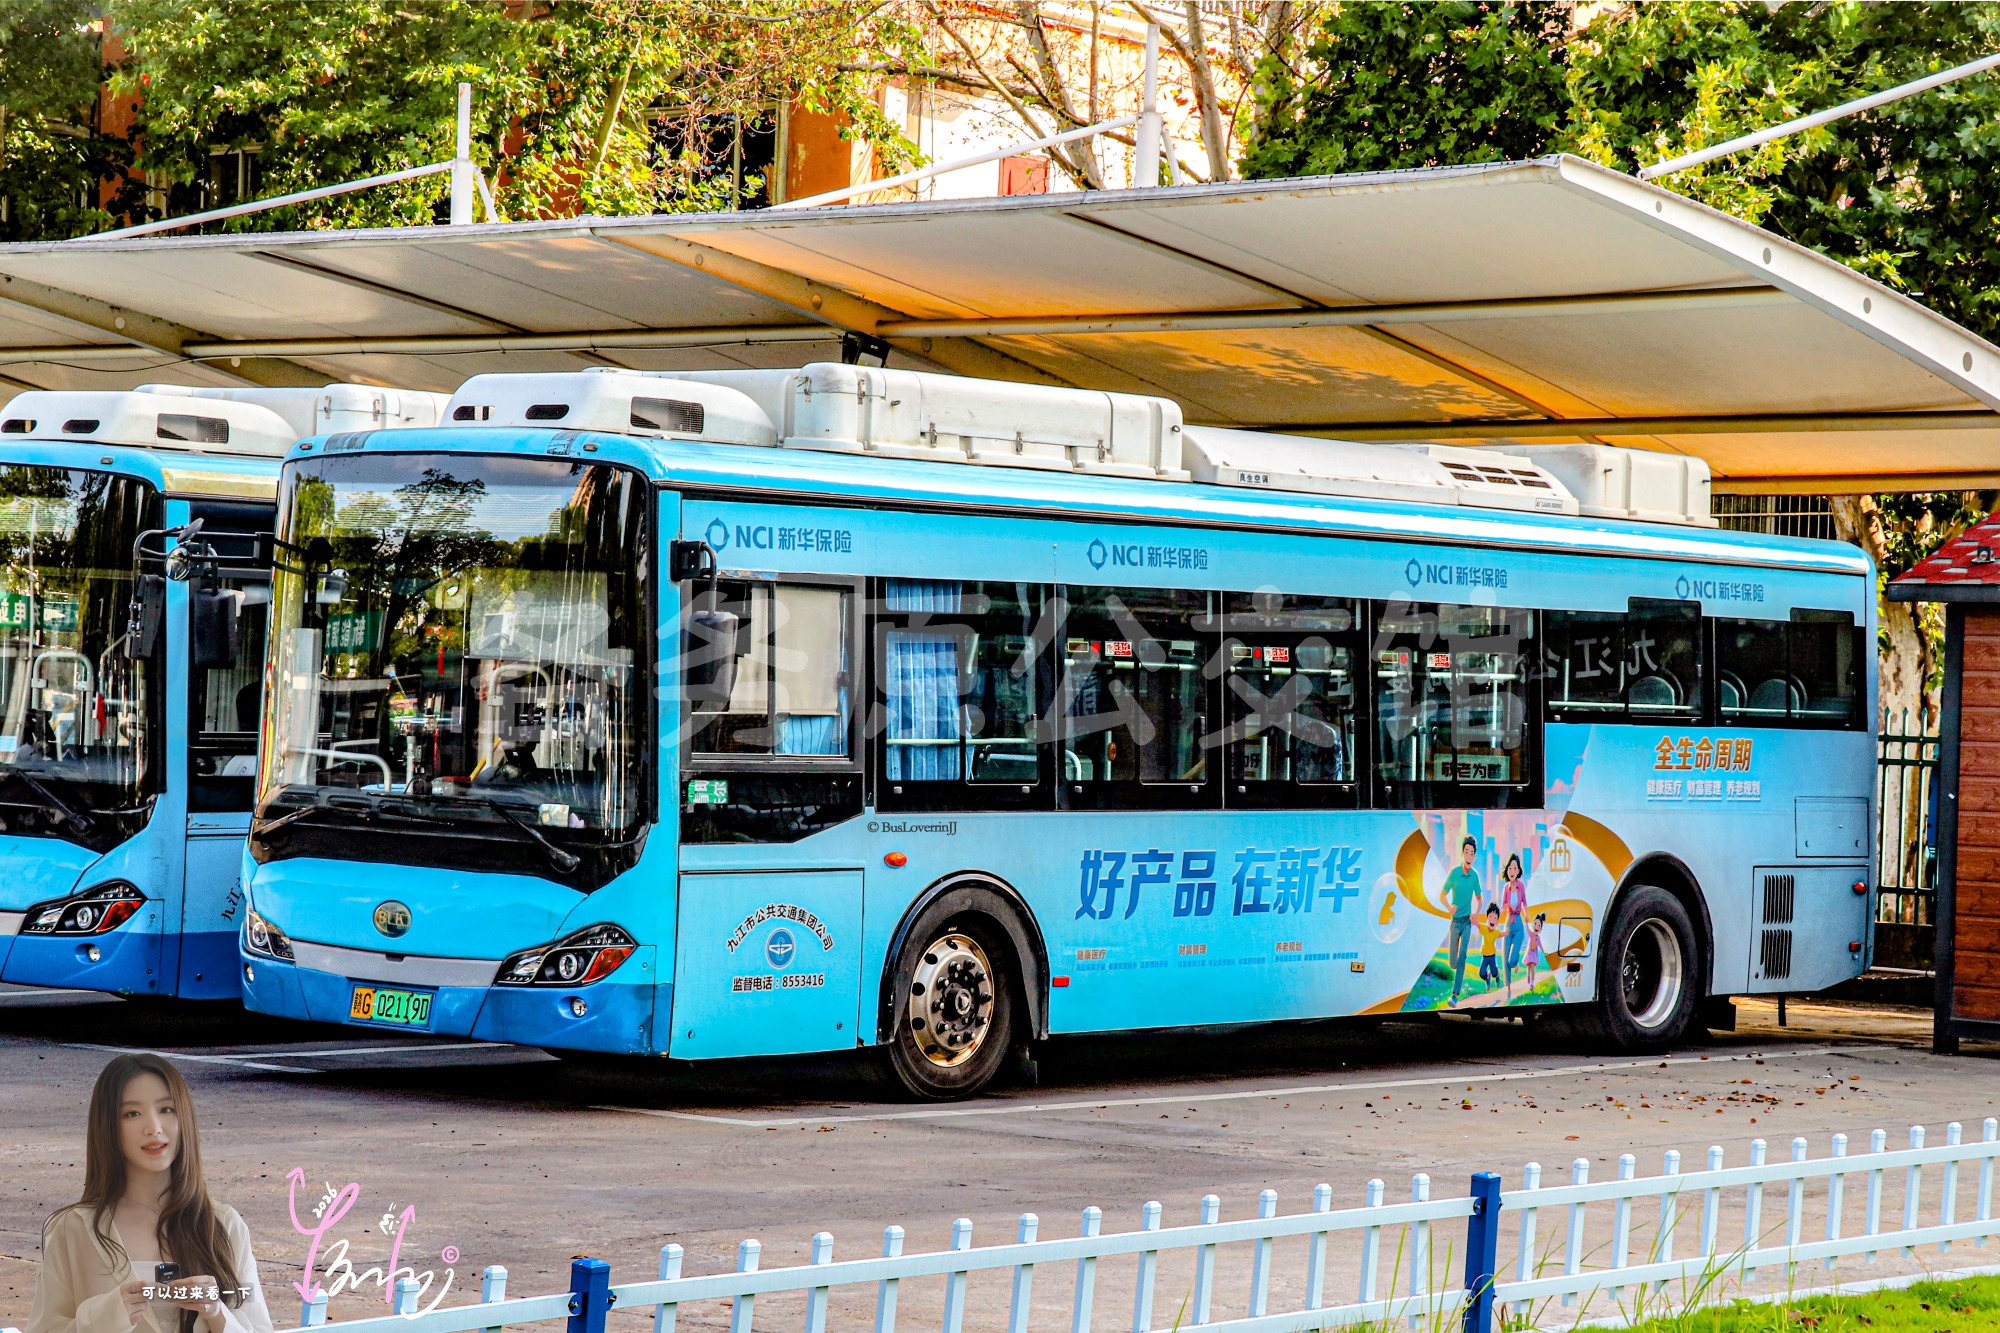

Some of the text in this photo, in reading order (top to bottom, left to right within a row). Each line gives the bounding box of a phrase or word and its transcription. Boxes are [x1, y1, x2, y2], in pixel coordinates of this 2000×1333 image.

[736, 525, 851, 553] NCI 新华保险
[1112, 544, 1208, 570] NCI 新华保险
[1426, 564, 1508, 588] NCI 新华保险
[1693, 580, 1764, 602] NCI 新华保险
[1654, 735, 1753, 772] 全生命周期
[1647, 780, 1761, 796] 健康医疗 财富管理 养老规划
[1075, 846, 1363, 921] 好产品 在新华
[727, 903, 834, 953] 九江市公共交通集团公司
